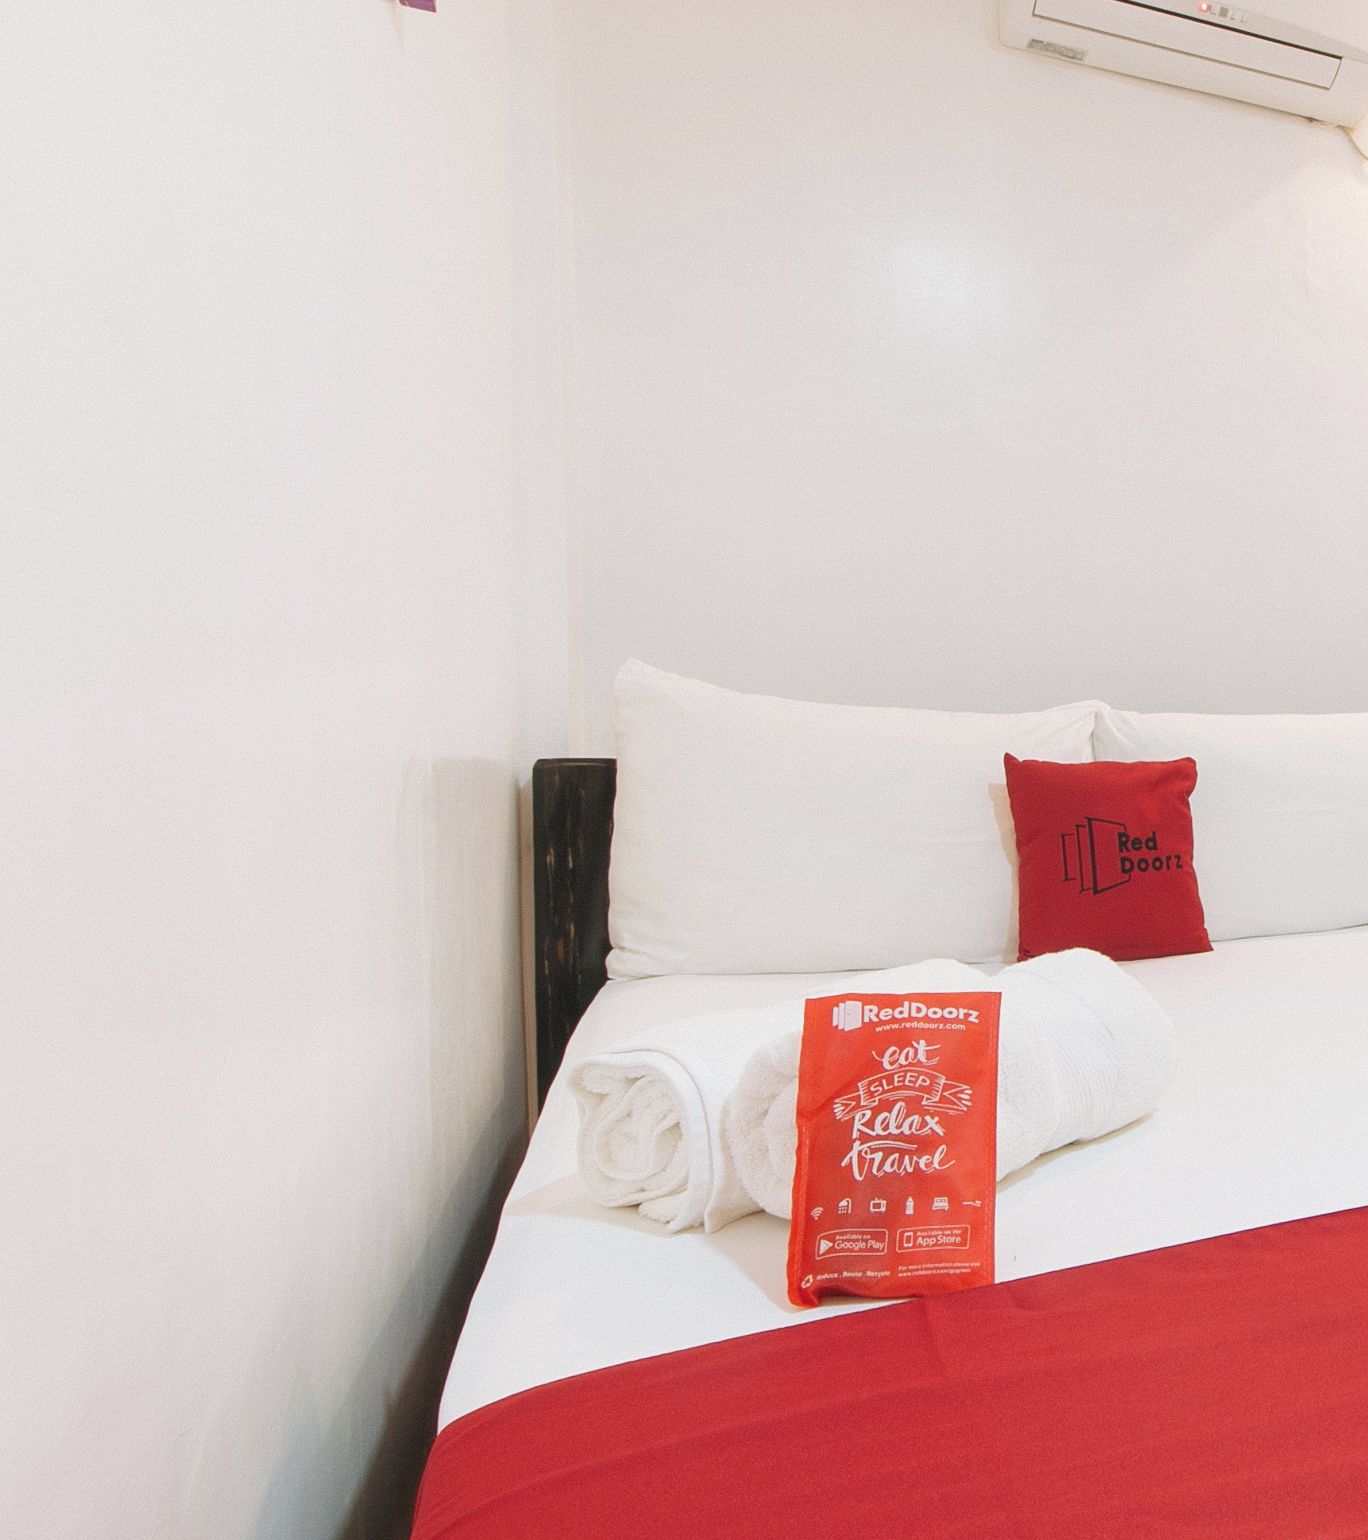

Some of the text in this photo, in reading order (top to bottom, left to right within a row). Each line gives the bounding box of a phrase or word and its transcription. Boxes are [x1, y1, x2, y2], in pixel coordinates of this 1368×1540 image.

[1117, 831, 1158, 853] Red
[1120, 854, 1183, 875] Doorz
[863, 1001, 979, 1023] RedDoorz
[875, 1021, 966, 1033] www.reddoorz.com
[872, 1039, 941, 1070] eat
[870, 1072, 931, 1096] SLEEP
[852, 1101, 946, 1139] Relax
[841, 1140, 956, 1181] travel
[834, 1240, 885, 1251] Google Play
[916, 1234, 961, 1247] App Store
